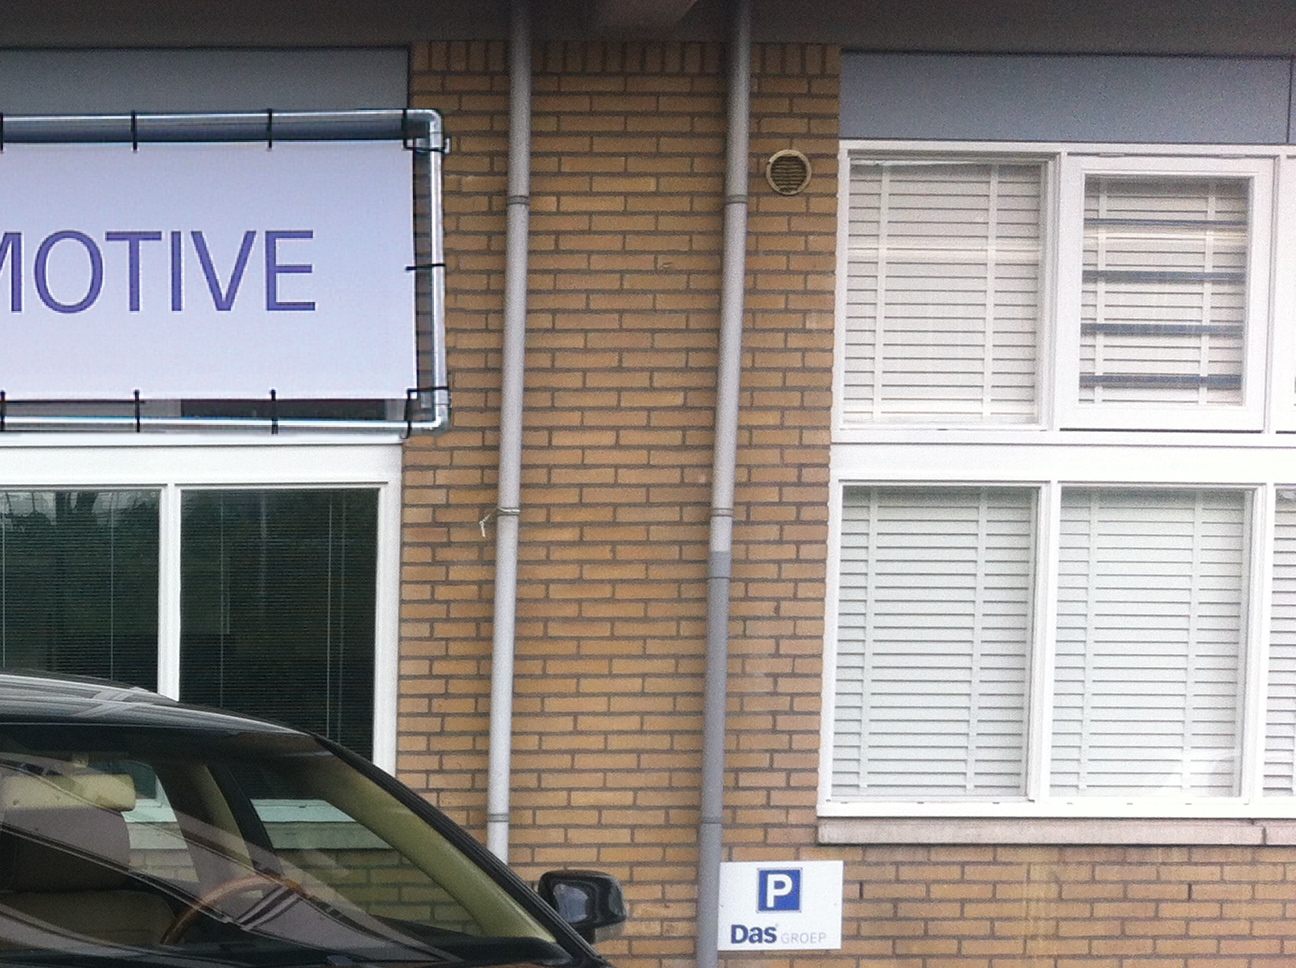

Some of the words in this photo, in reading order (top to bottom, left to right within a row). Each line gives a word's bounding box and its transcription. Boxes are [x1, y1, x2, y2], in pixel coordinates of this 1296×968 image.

[766, 873, 793, 908] P
[730, 924, 777, 944] Das
[780, 932, 827, 945] GROEP
